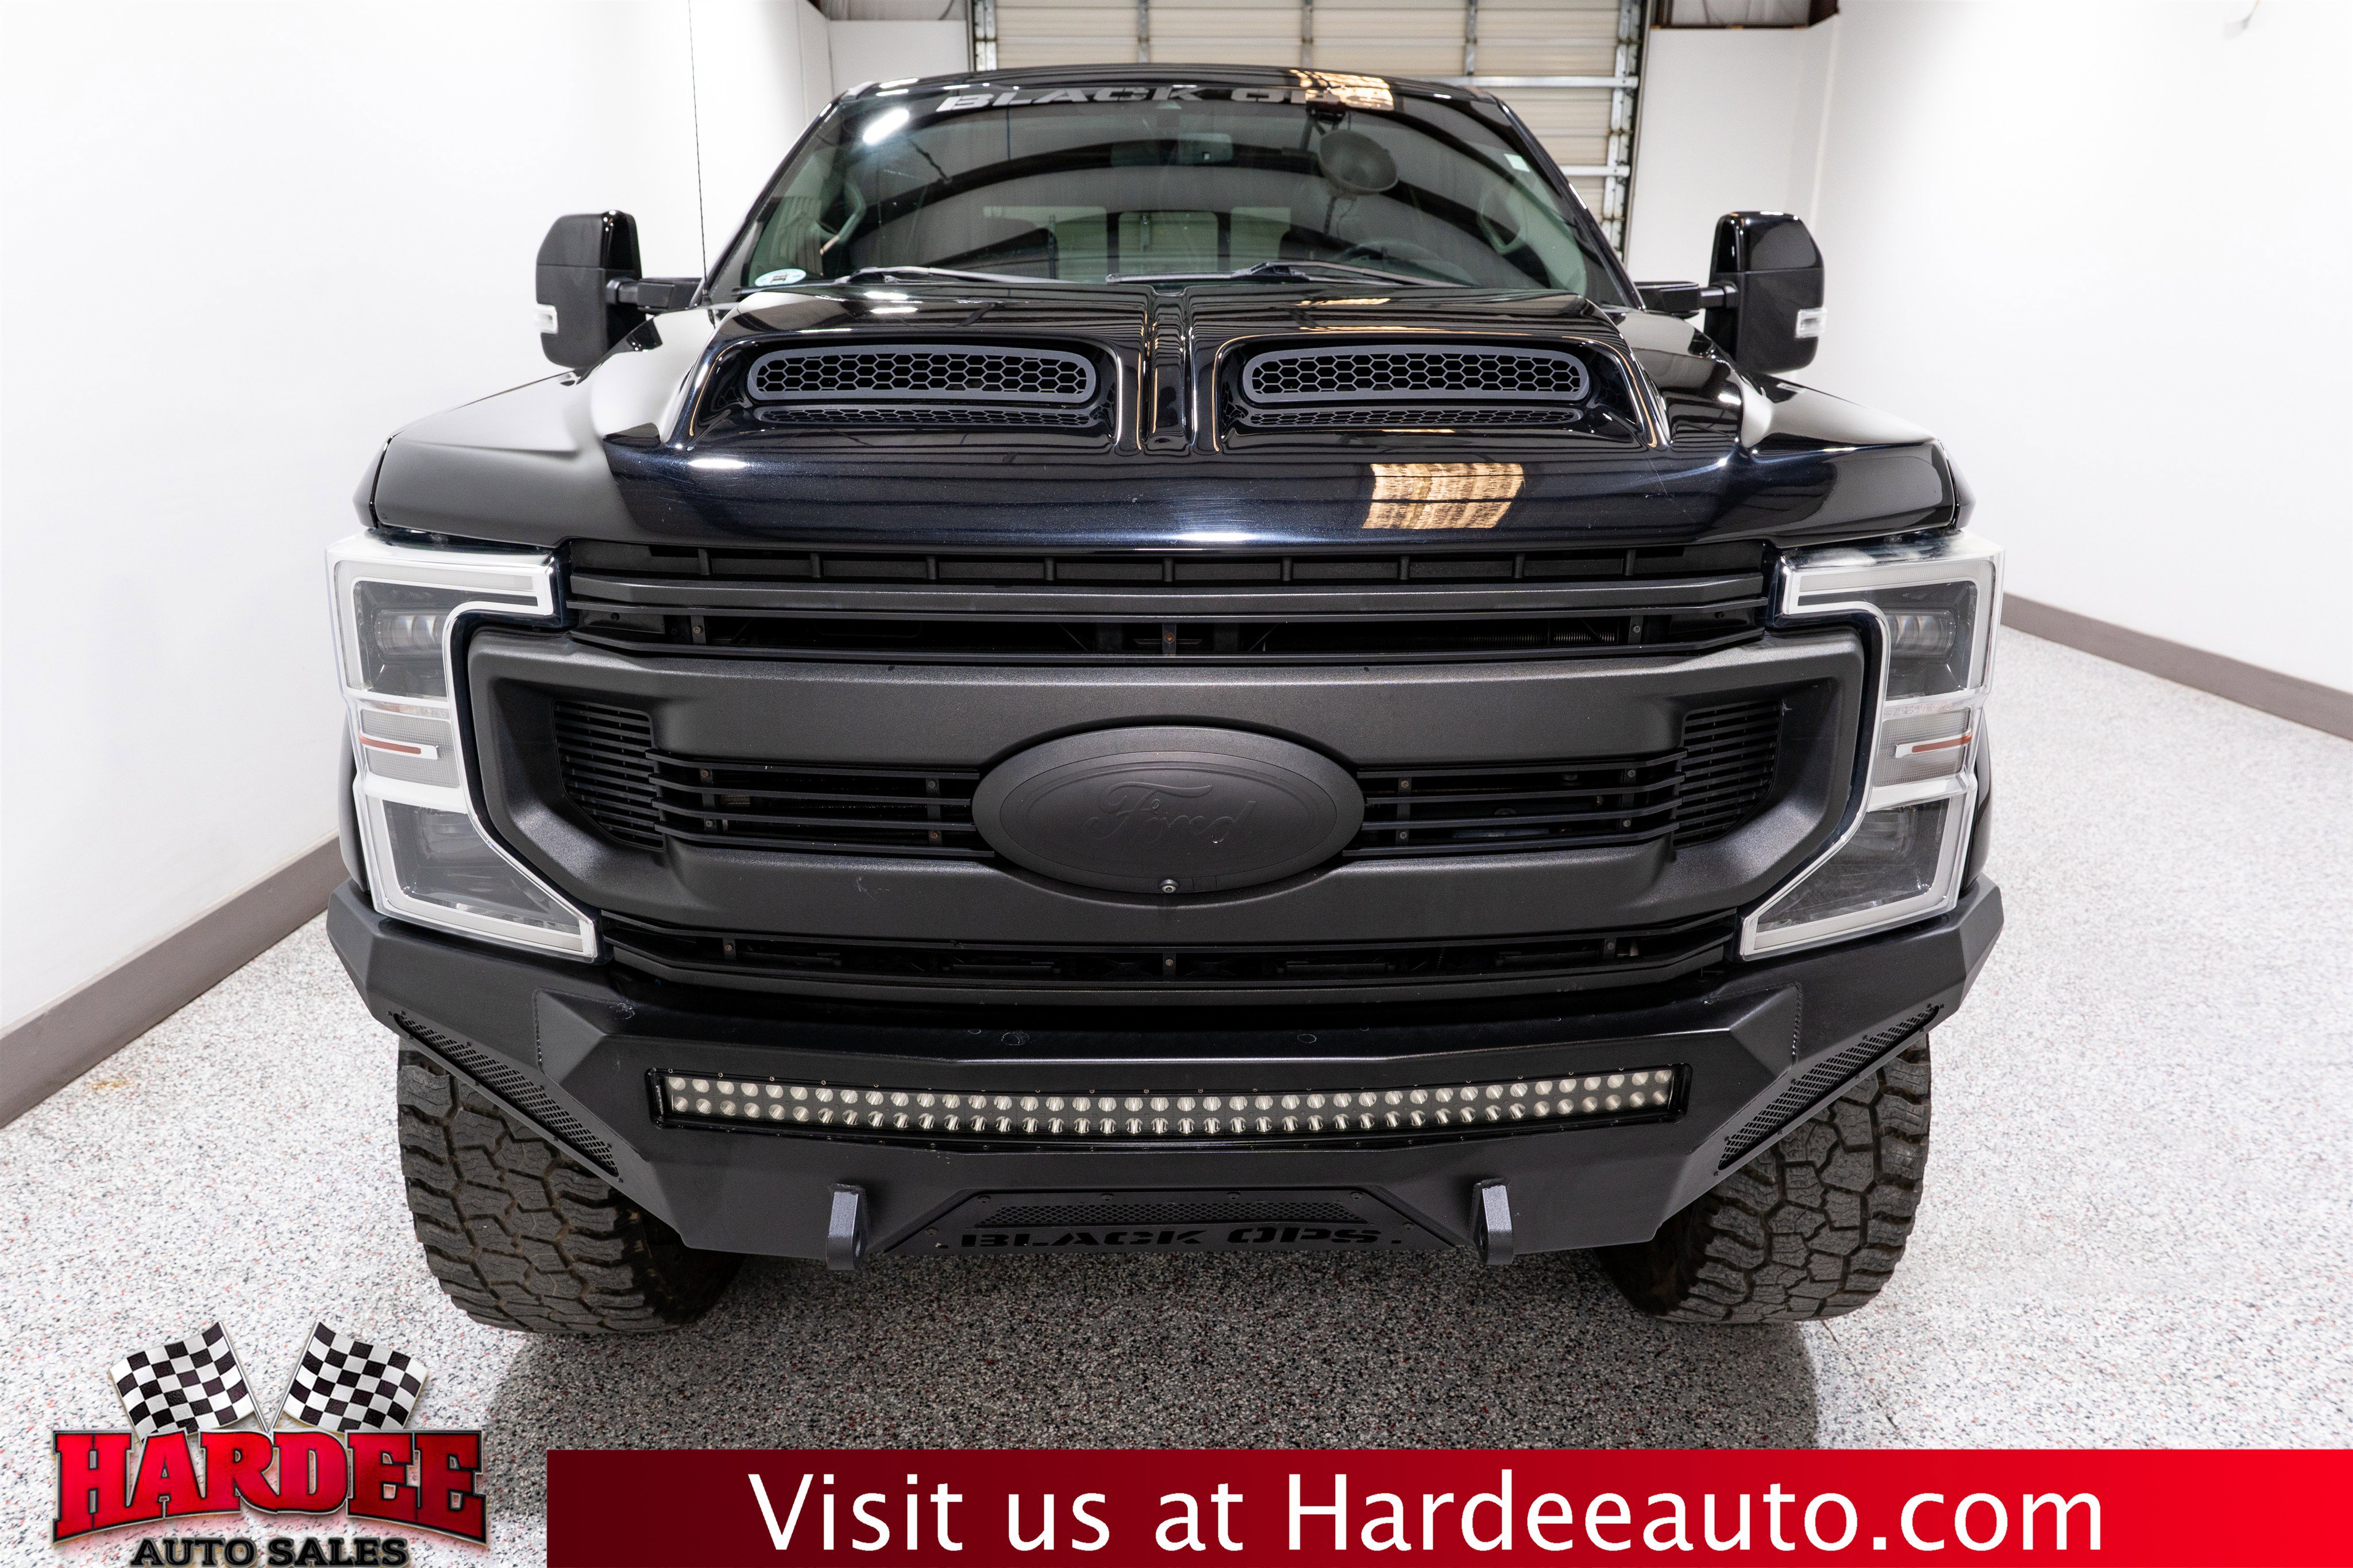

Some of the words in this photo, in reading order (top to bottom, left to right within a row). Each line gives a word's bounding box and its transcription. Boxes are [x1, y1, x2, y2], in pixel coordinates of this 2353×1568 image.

[936, 87, 1206, 113] BLACK
[1082, 781, 1257, 844] Ford
[961, 1227, 1209, 1248] BLACK
[1225, 1226, 1381, 1245] OPS
